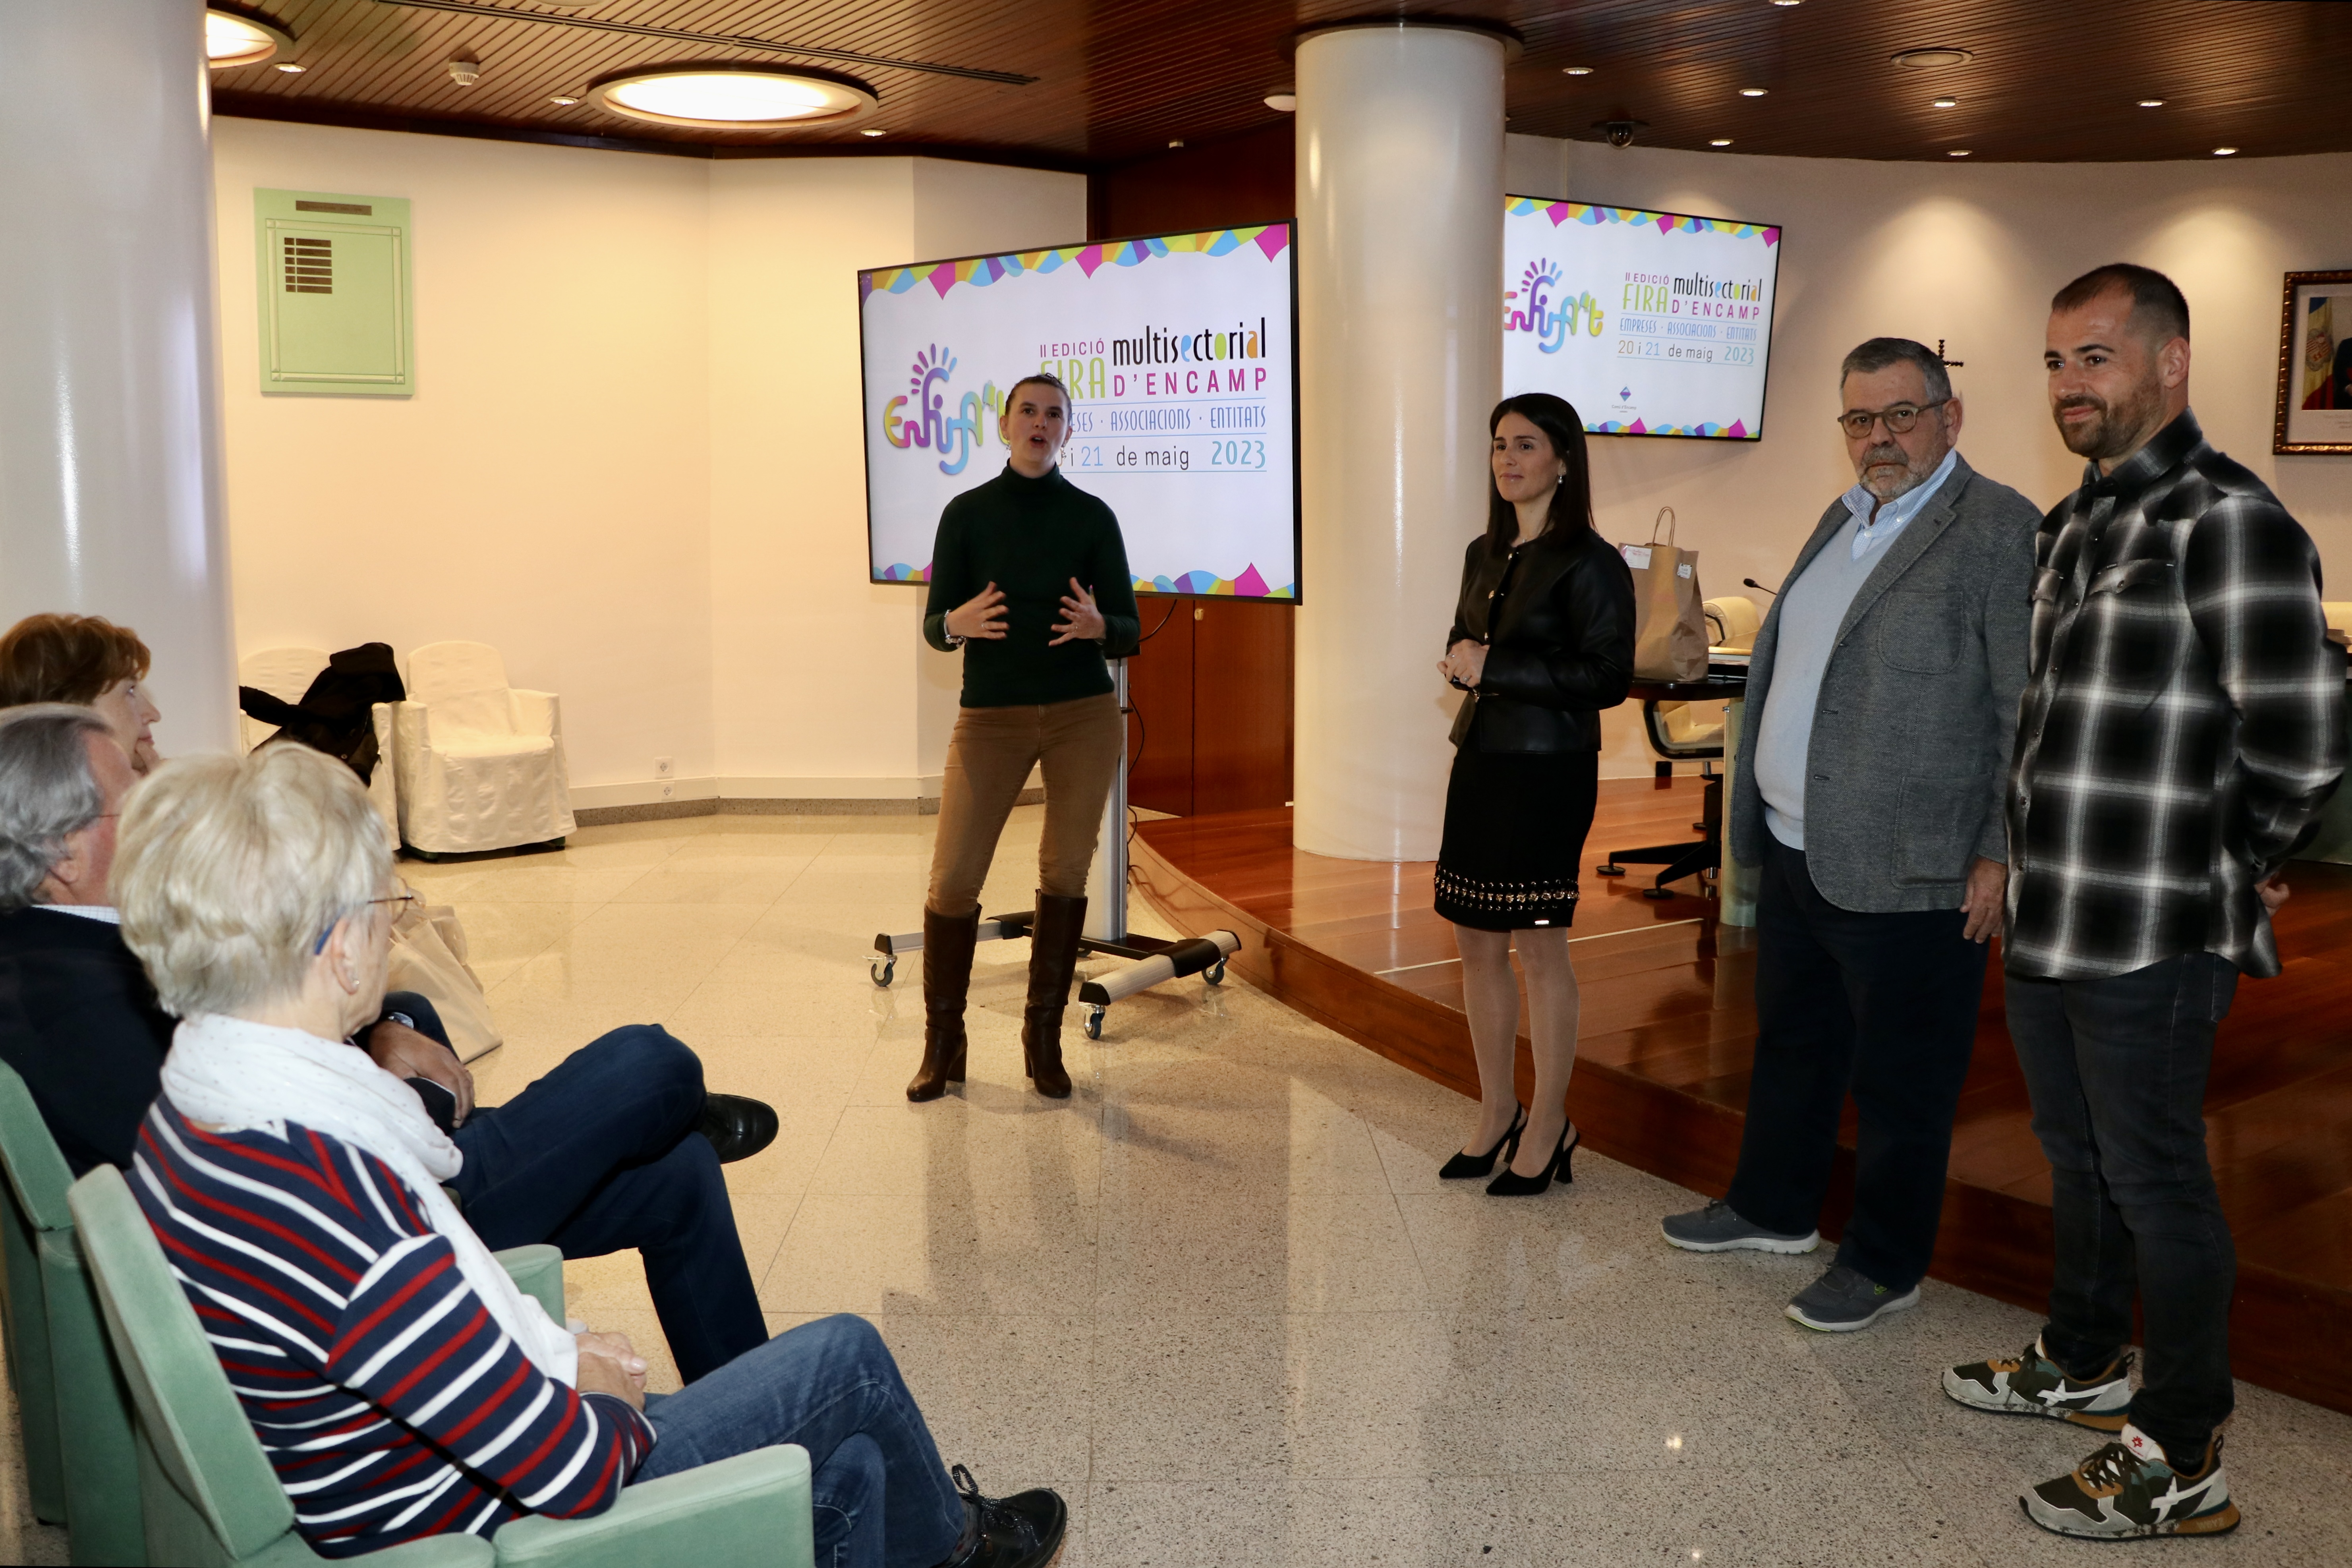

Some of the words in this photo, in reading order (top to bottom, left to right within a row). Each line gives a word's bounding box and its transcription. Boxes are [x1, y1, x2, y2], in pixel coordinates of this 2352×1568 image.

[1633, 273, 1669, 285] EDICIÓ
[1674, 272, 1762, 302] multisectorial
[1623, 284, 1668, 313] FIRA
[1672, 300, 1760, 320] D'ENCAMP
[1113, 317, 1266, 366] multisectorial
[1620, 318, 1657, 333] EMPRESES
[1667, 321, 1716, 338] ASSOCIACIONS
[1726, 327, 1757, 341] ENTITATS
[1040, 344, 1046, 358] II
[1052, 338, 1104, 357] EDICIÓ
[1618, 340, 1634, 354] 20
[1638, 342, 1641, 354] i
[1645, 342, 1660, 356] 21
[1668, 344, 1681, 357] de
[1686, 347, 1713, 362] maig
[1725, 346, 1754, 364] 2023
[1114, 367, 1266, 396] D'ENCAMP
[1111, 408, 1191, 431] ASSOCIACIONS
[1210, 406, 1266, 428] ENTITATS
[1071, 448, 1073, 466] i
[1081, 446, 1103, 466] 21
[1117, 445, 1137, 466] de
[1145, 446, 1189, 470] maig
[1212, 440, 1266, 469] 2023
